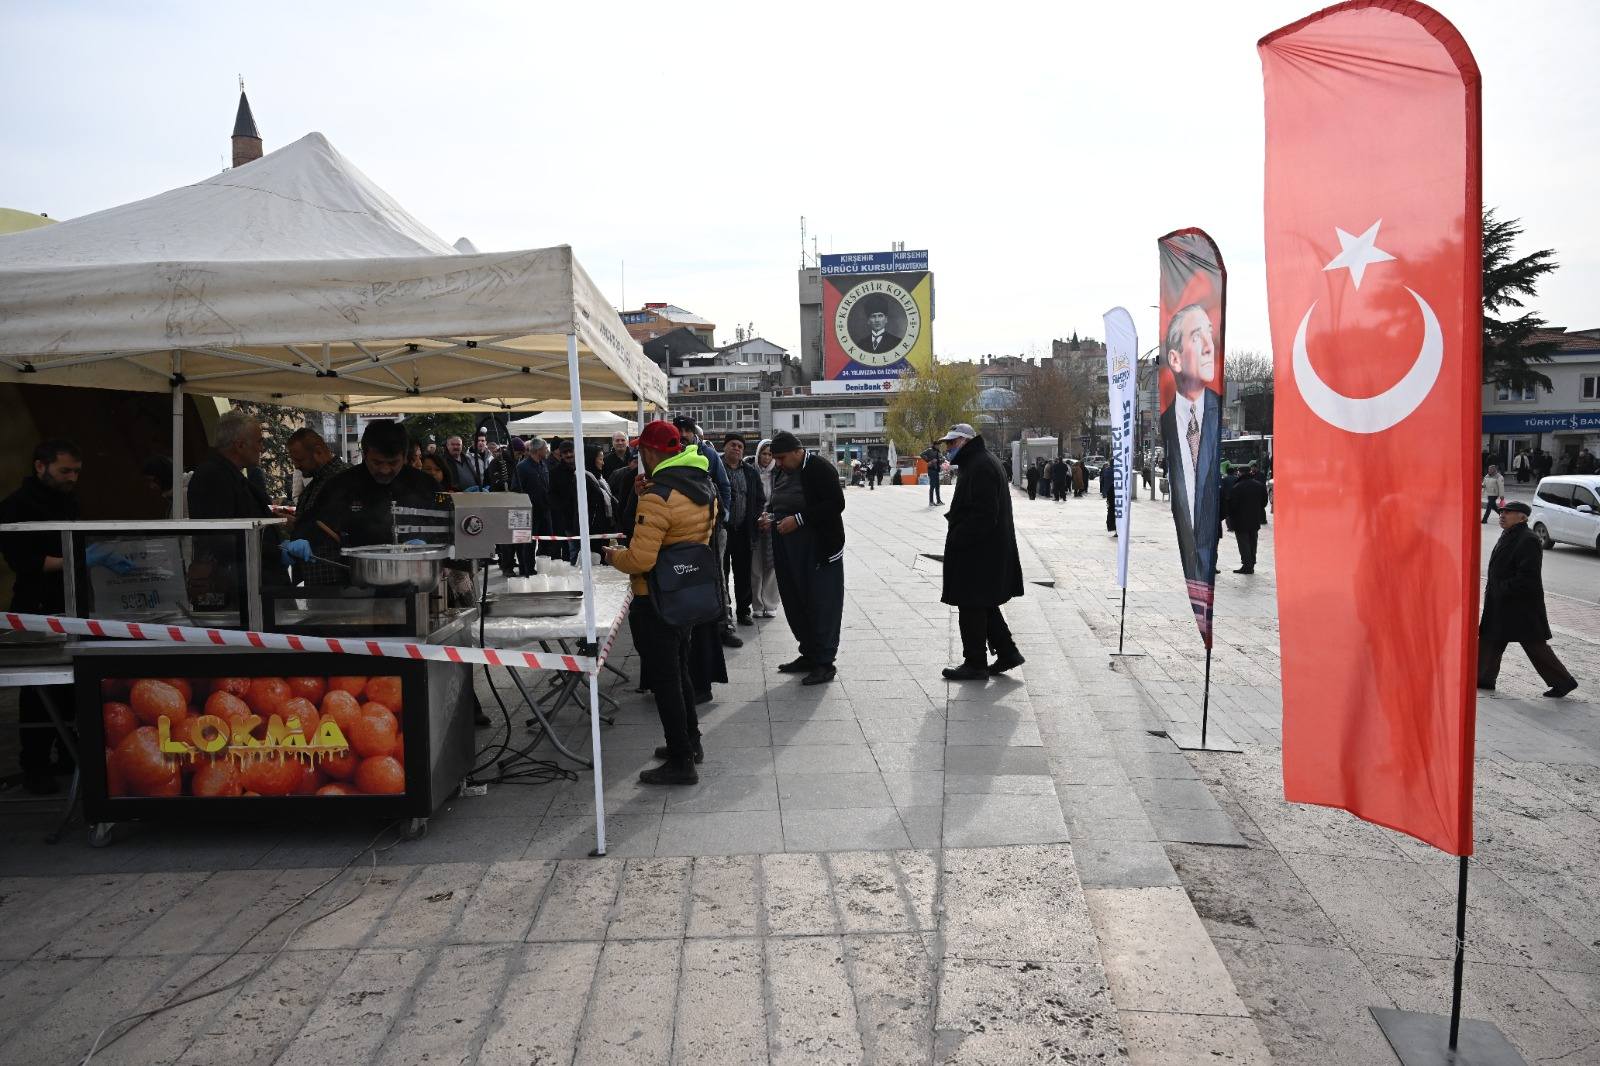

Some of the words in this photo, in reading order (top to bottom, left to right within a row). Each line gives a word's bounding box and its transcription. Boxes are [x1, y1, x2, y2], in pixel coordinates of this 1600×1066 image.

[840, 254, 874, 264] KIRŞEHİR
[894, 251, 928, 261] KIRŞEHİR
[821, 264, 858, 274] SÜRÜCÜ
[860, 263, 893, 272] KURSU
[845, 383, 881, 391] DenizBank
[1525, 418, 1567, 426] TÜRKİYE
[158, 713, 351, 757] LOKMA
